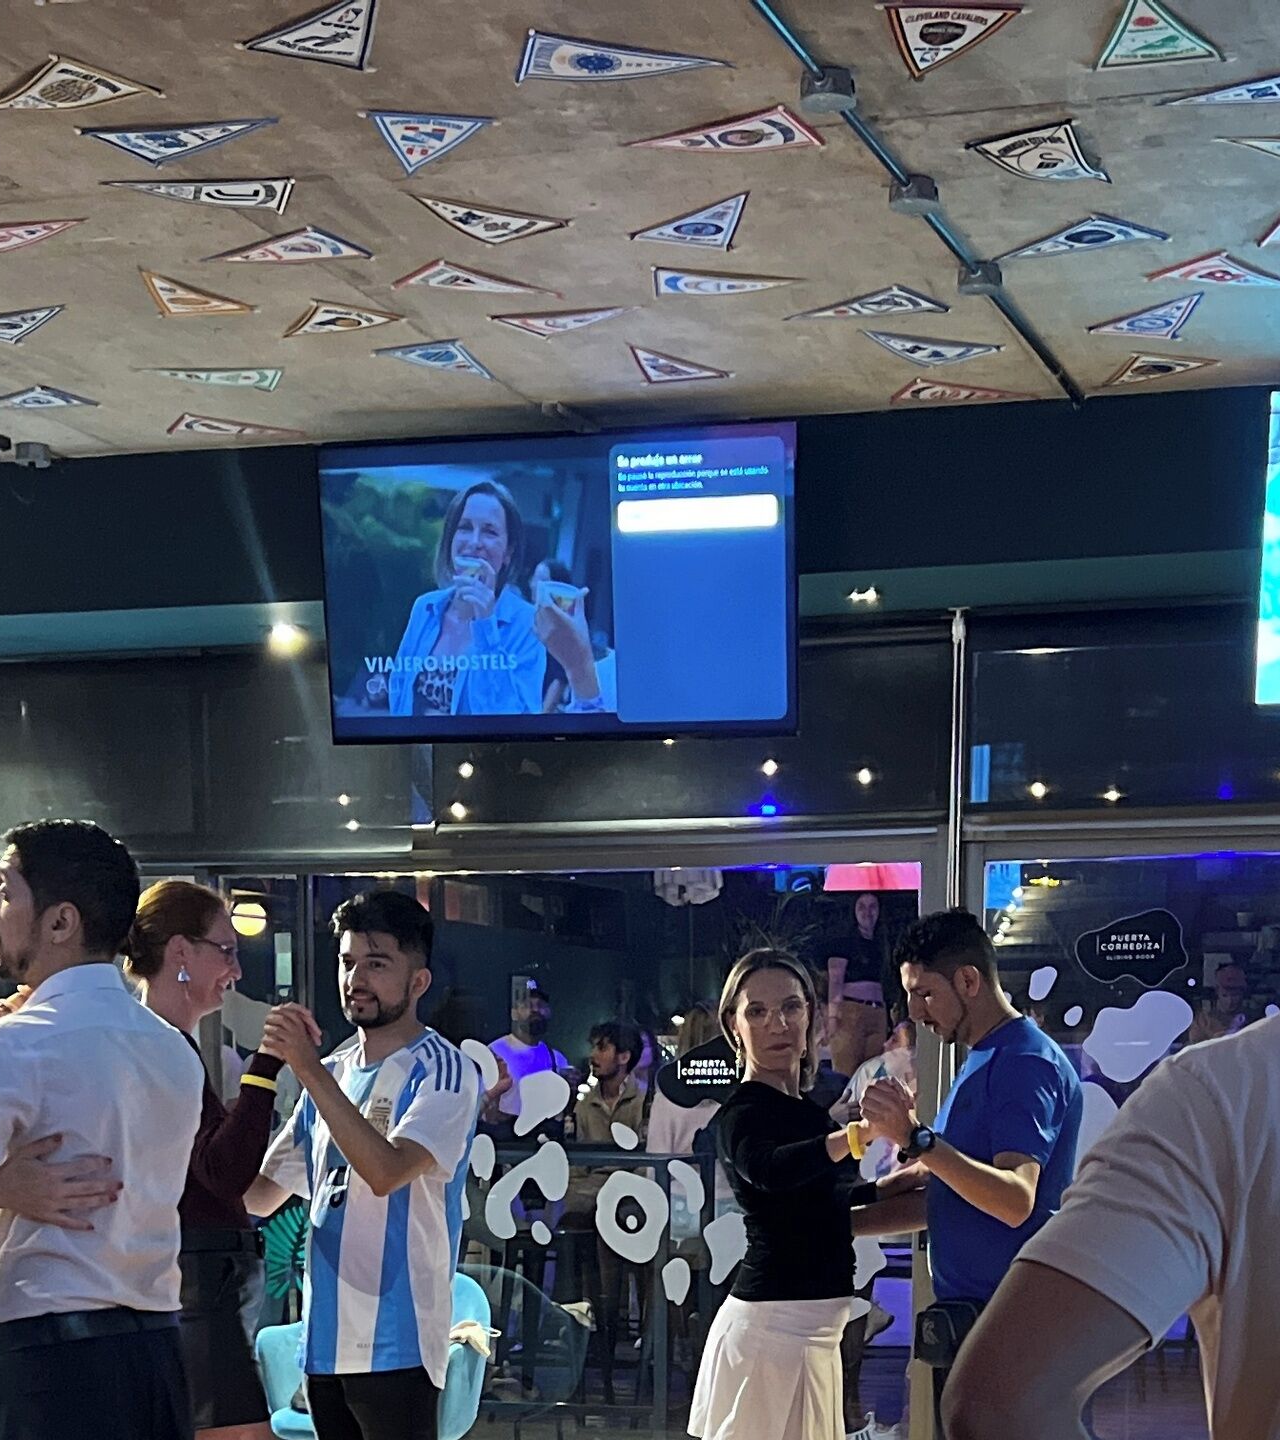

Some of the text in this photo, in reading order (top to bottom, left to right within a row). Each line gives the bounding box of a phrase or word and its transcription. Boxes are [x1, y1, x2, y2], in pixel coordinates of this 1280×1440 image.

[905, 11, 988, 25] CLEVELAND CAVALIERS
[617, 453, 703, 468] Se produjo un error
[364, 654, 519, 673] VIAJERO HOSTELS
[1110, 934, 1150, 942] PUERTA
[1100, 942, 1160, 951] CORREDIZA
[690, 1060, 726, 1068] PUERTA
[681, 1068, 735, 1076] CORREDIZA
